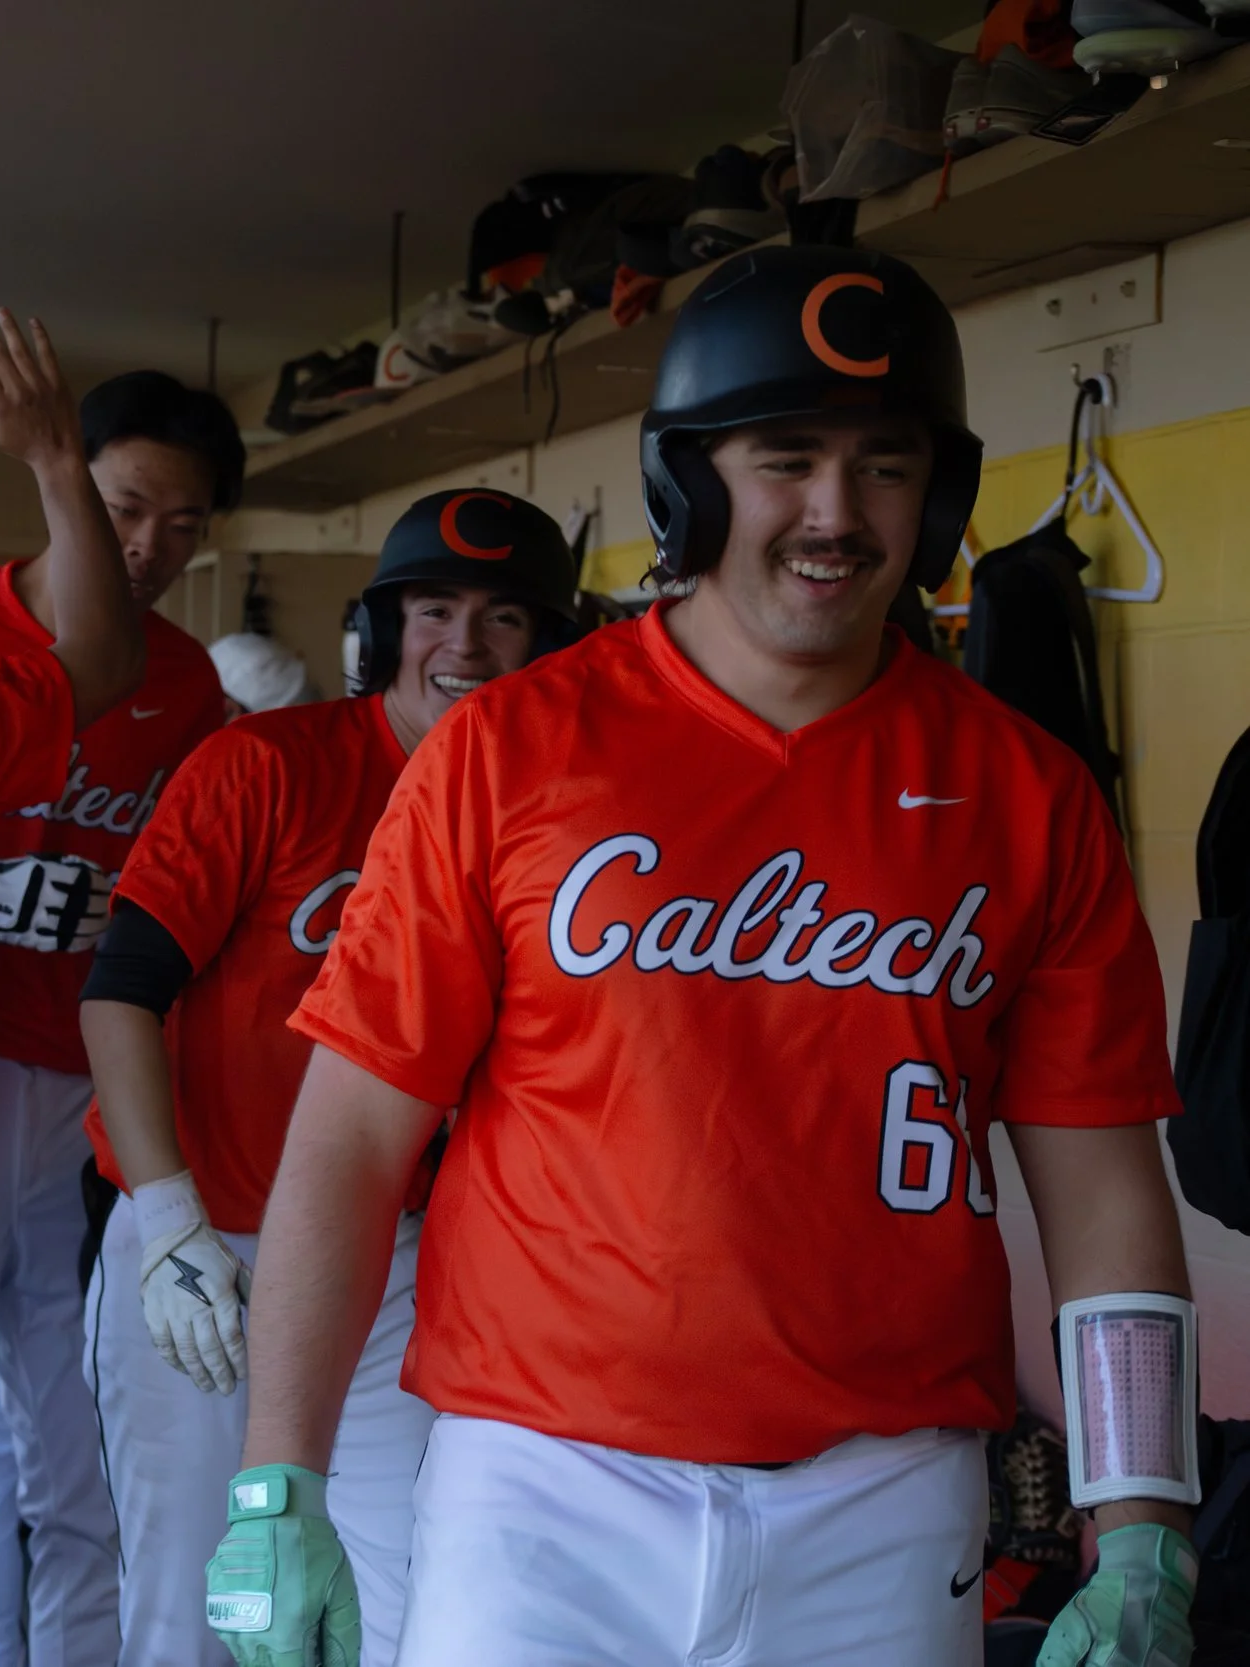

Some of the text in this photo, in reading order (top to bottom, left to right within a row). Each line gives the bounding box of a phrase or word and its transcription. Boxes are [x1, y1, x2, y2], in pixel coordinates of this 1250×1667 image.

[801, 272, 890, 378] C
[439, 490, 513, 560] C
[547, 832, 996, 1007] Caltech
[208, 1598, 267, 1626] Franklin
